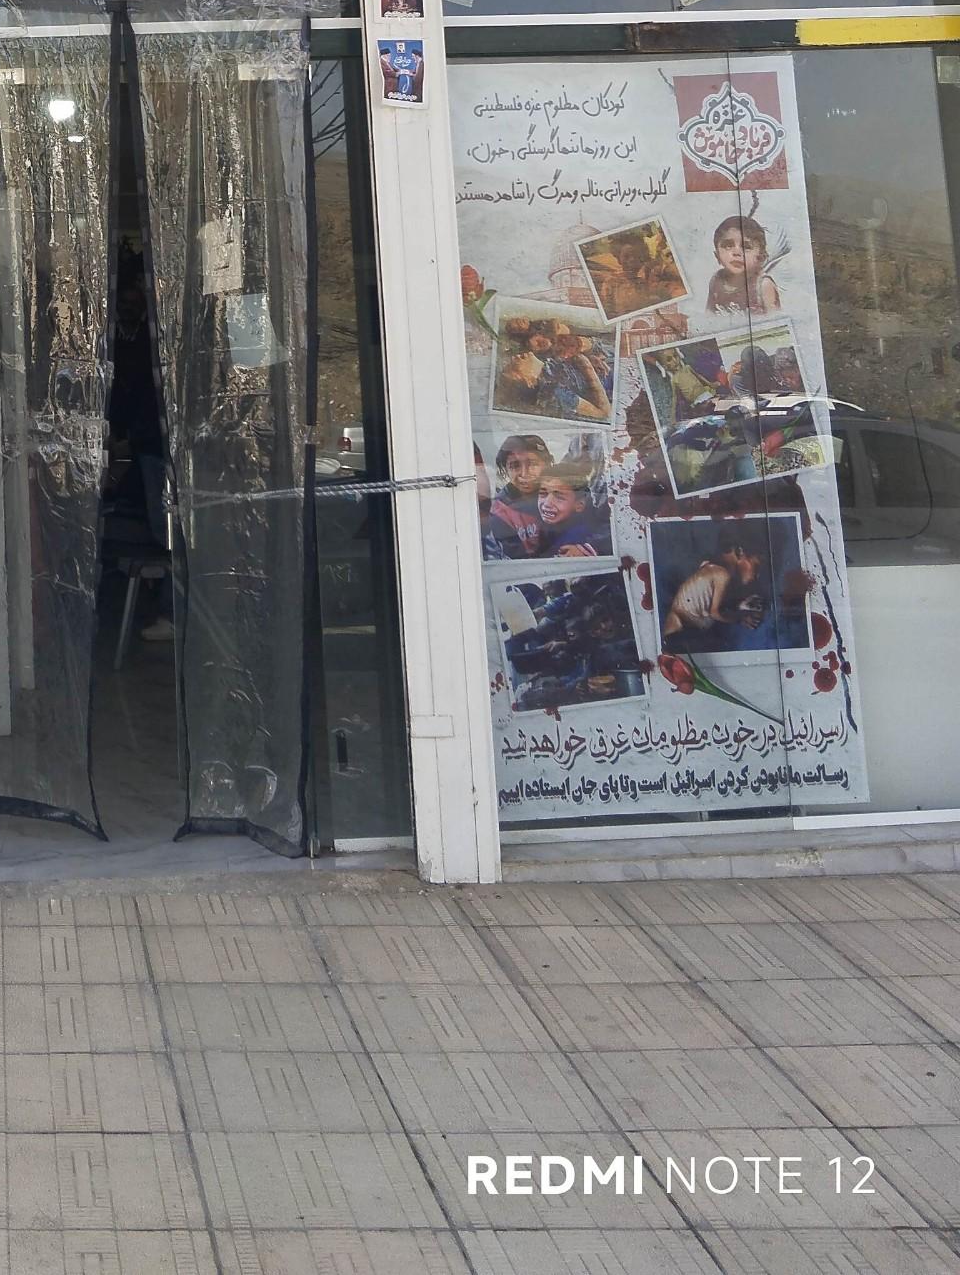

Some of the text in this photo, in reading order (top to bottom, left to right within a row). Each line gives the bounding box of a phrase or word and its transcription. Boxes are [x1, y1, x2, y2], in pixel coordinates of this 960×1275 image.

[473, 81, 628, 125] کودکان مظلوم غزه فلسطینی
[579, 136, 611, 160] روزها
[613, 135, 638, 163] این
[501, 709, 848, 770] اسرائیل در خون مظلومان غرق خواهد شد
[571, 775, 598, 805] جان
[638, 771, 668, 795] است
[670, 768, 716, 799] اسرائیل
[717, 764, 750, 797] کردن
[802, 762, 850, 790] رسالت
